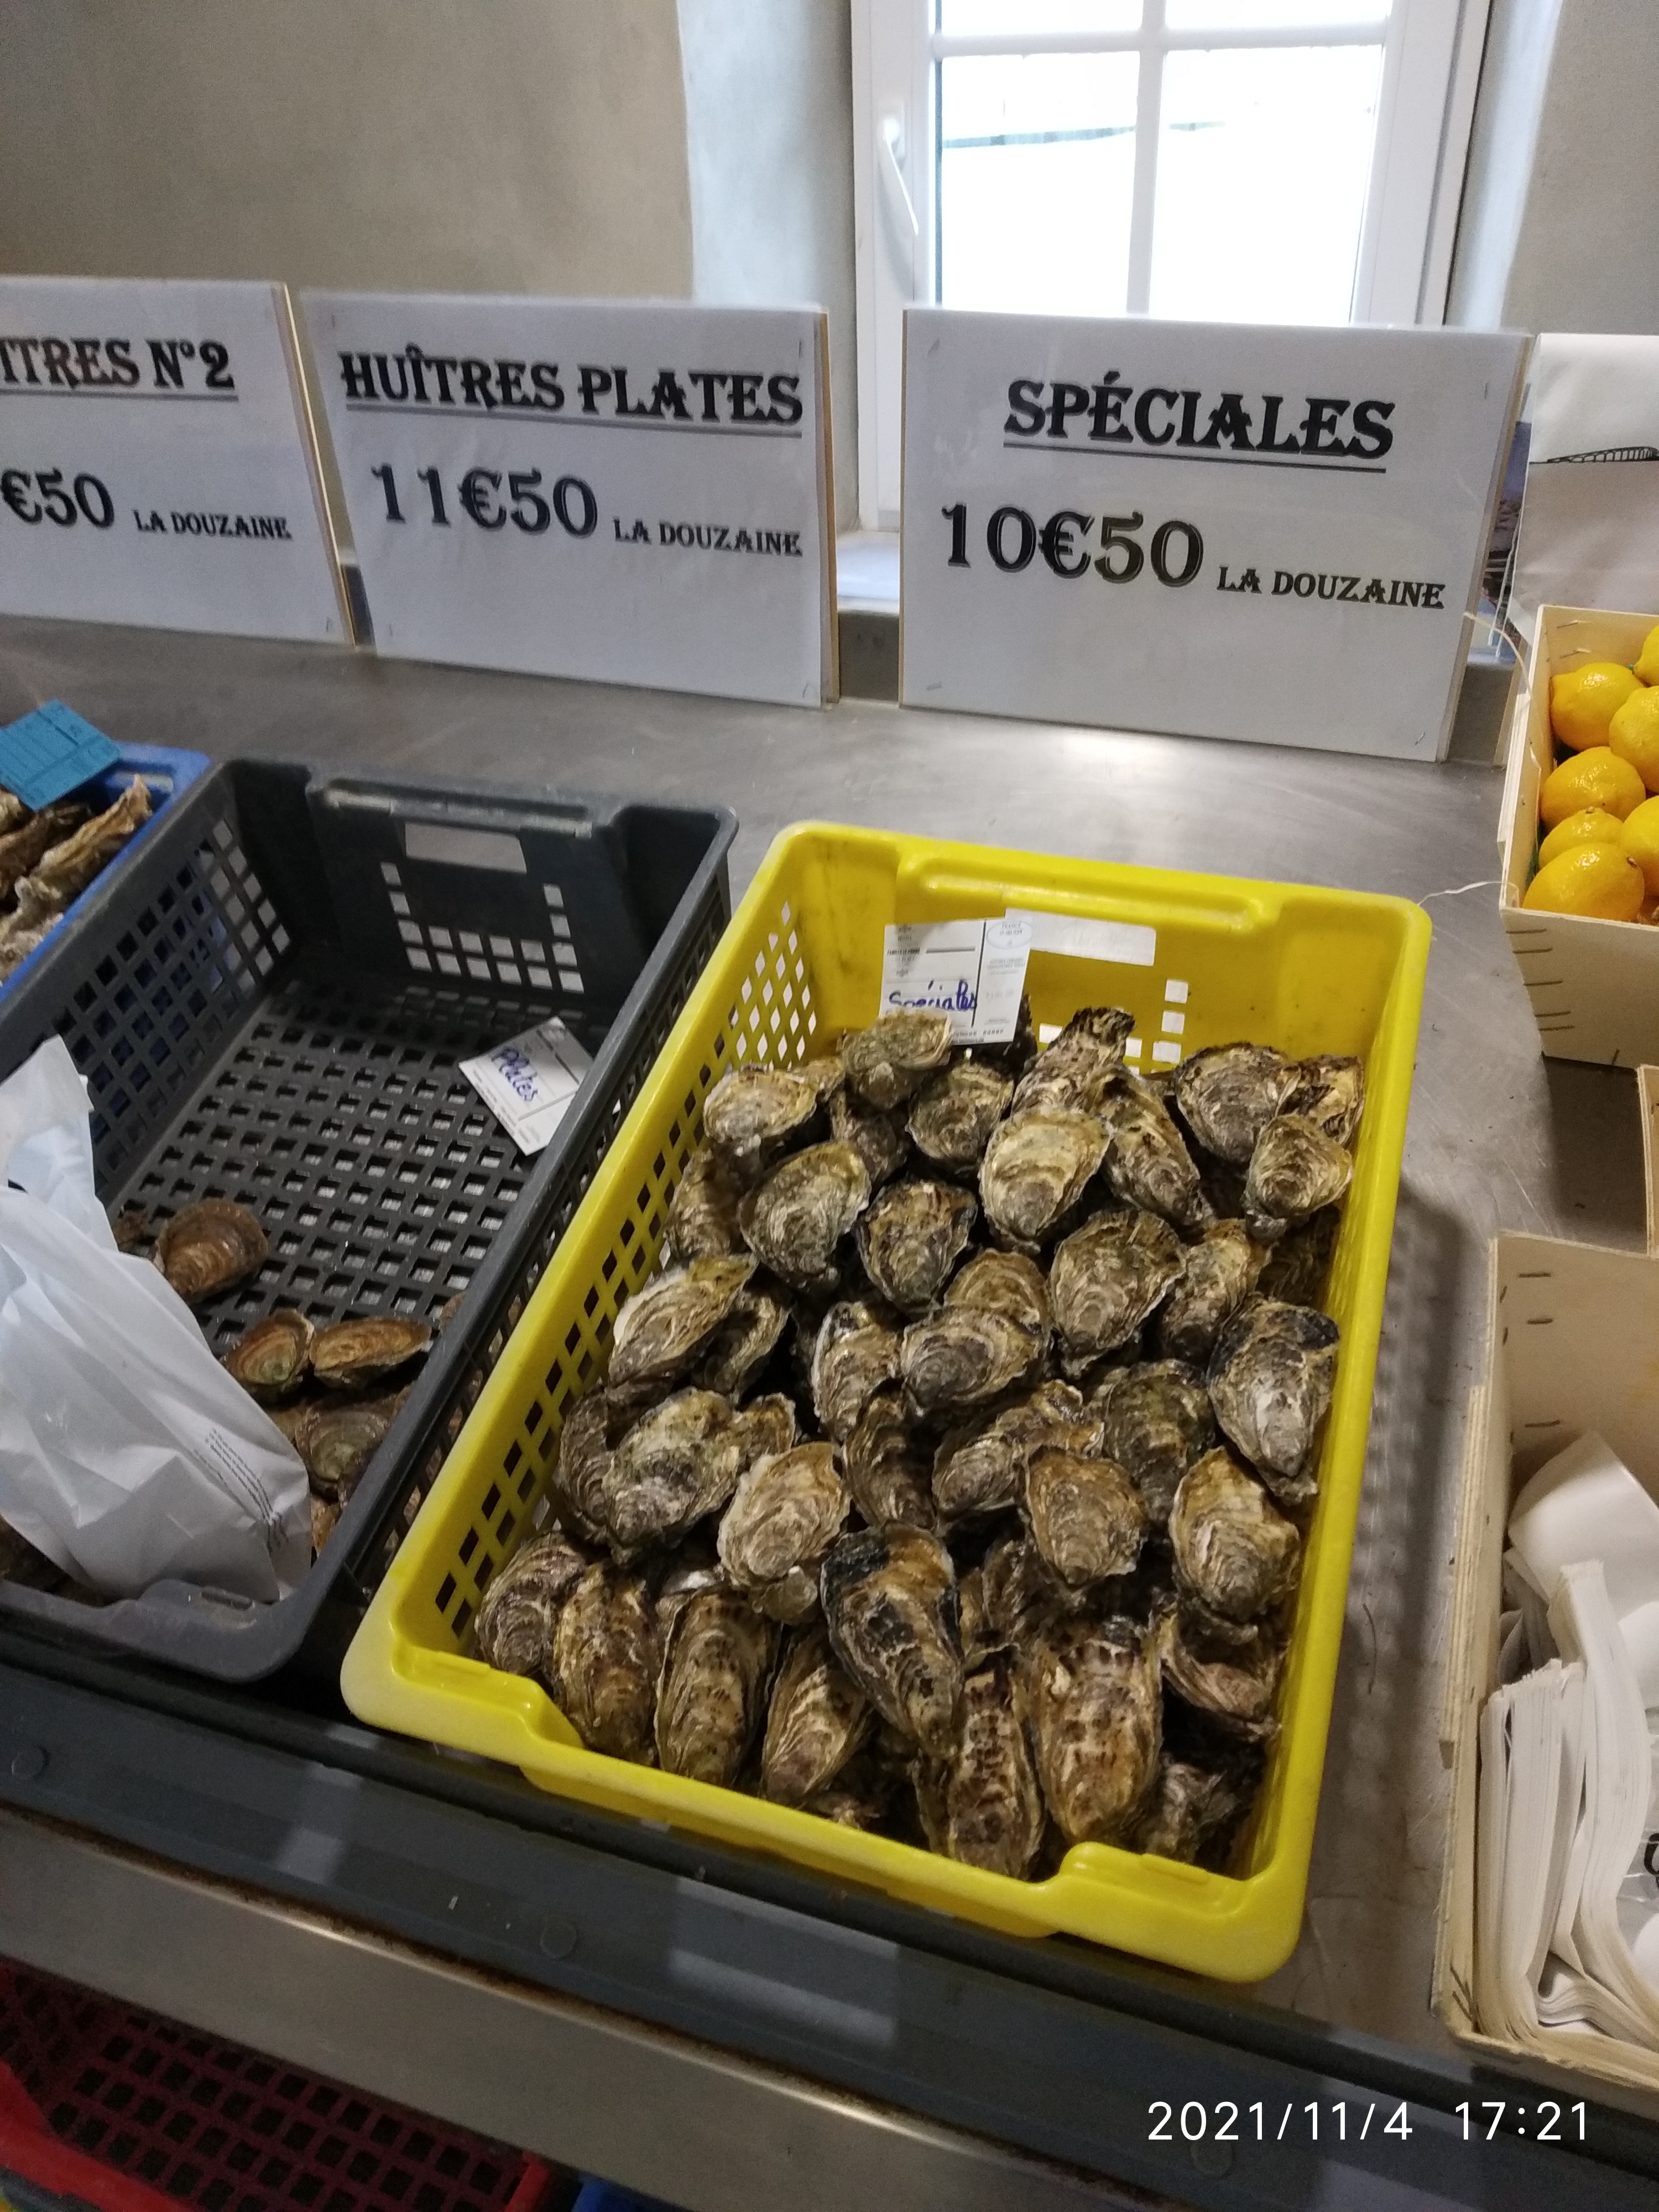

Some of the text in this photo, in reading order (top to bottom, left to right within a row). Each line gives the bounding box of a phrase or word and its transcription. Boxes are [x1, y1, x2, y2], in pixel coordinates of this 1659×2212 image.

[338, 343, 803, 425] HUÎTRES PLATES
[1004, 370, 1396, 460] SPÉCIALES
[0, 467, 293, 540] €50 LA DOUZAINE
[371, 463, 803, 557] 11€50 LA DOUZAINE
[941, 502, 1447, 609] 10€50 LA DOUZAINE
